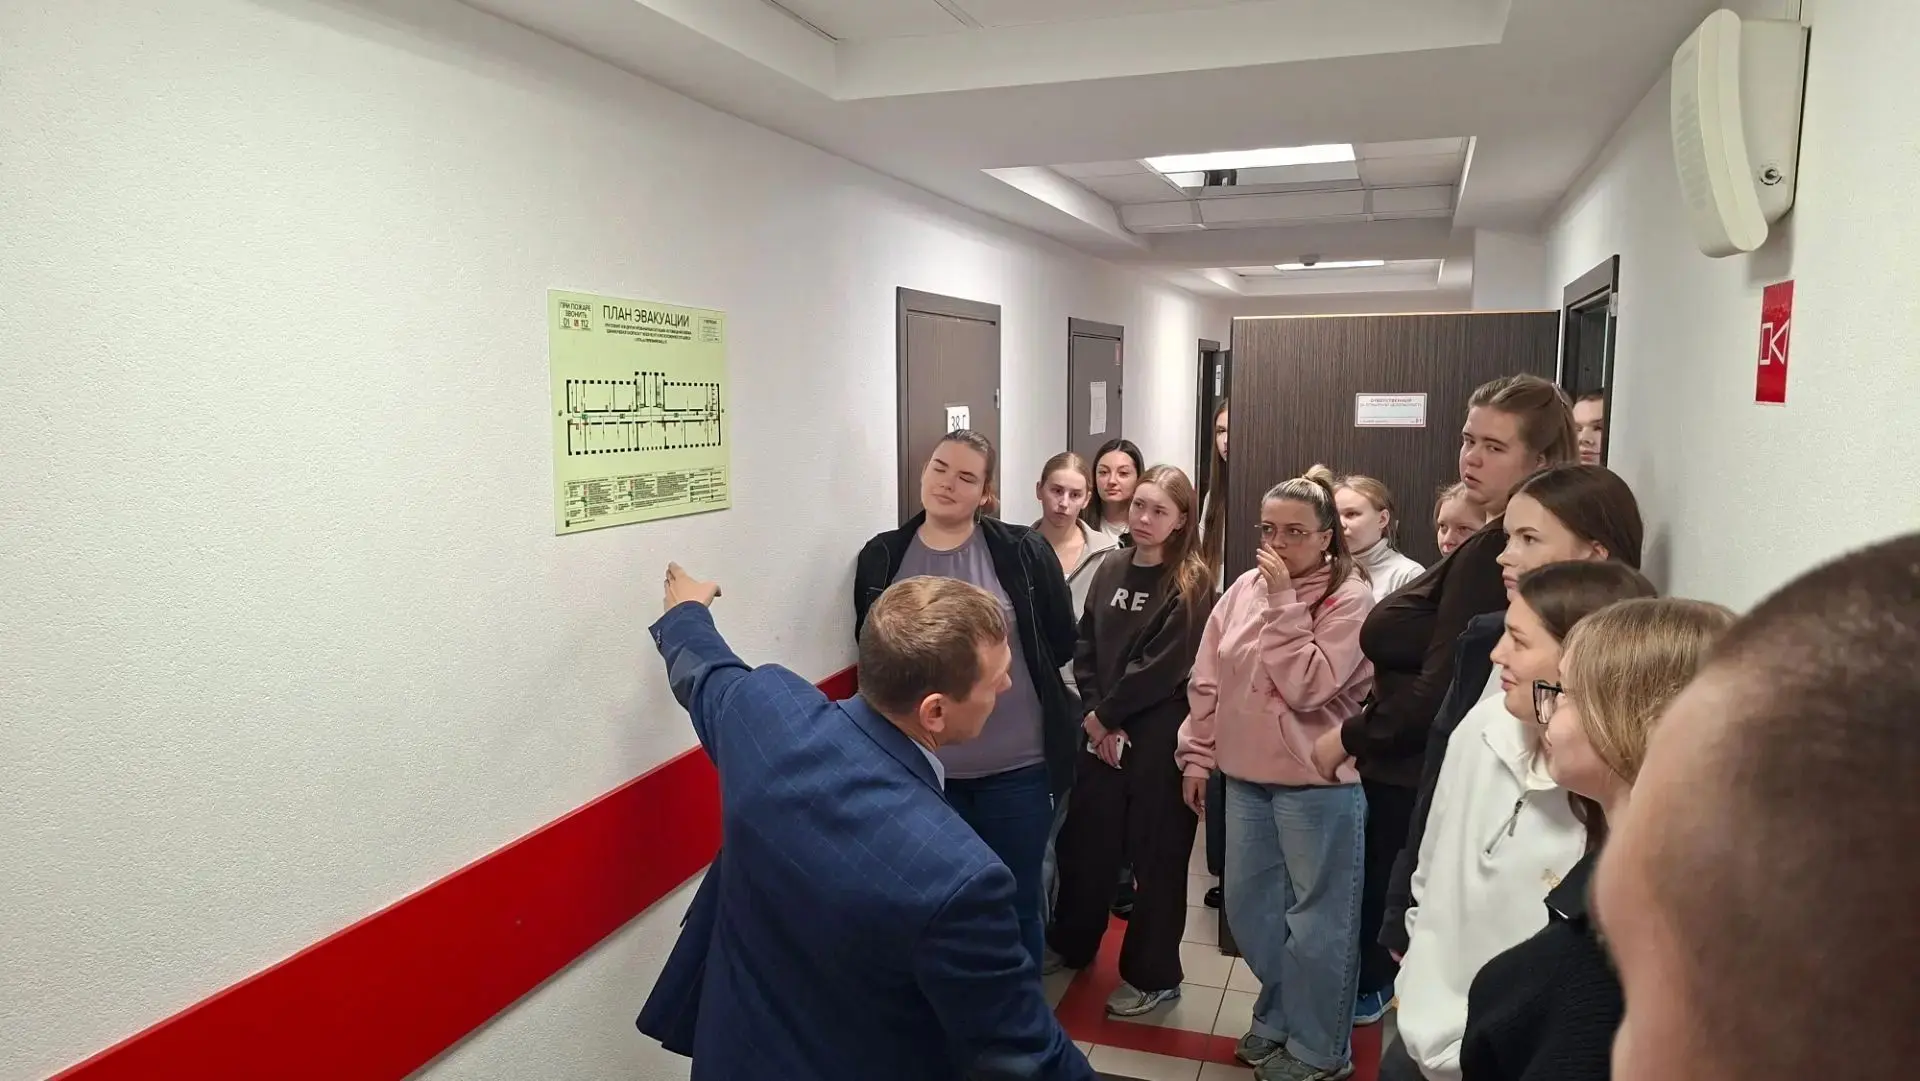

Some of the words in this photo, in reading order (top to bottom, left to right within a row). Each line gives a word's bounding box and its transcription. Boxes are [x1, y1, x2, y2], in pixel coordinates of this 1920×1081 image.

[560, 301, 570, 309] ПРИ
[571, 303, 592, 312] ПОЖАРЕ
[565, 310, 588, 319] ЗВОНИТЬ
[603, 305, 632, 321] ПЛАН
[634, 308, 690, 328] ЭВАКУАЦИИ
[581, 319, 590, 328] 112
[1110, 587, 1149, 611] RE
